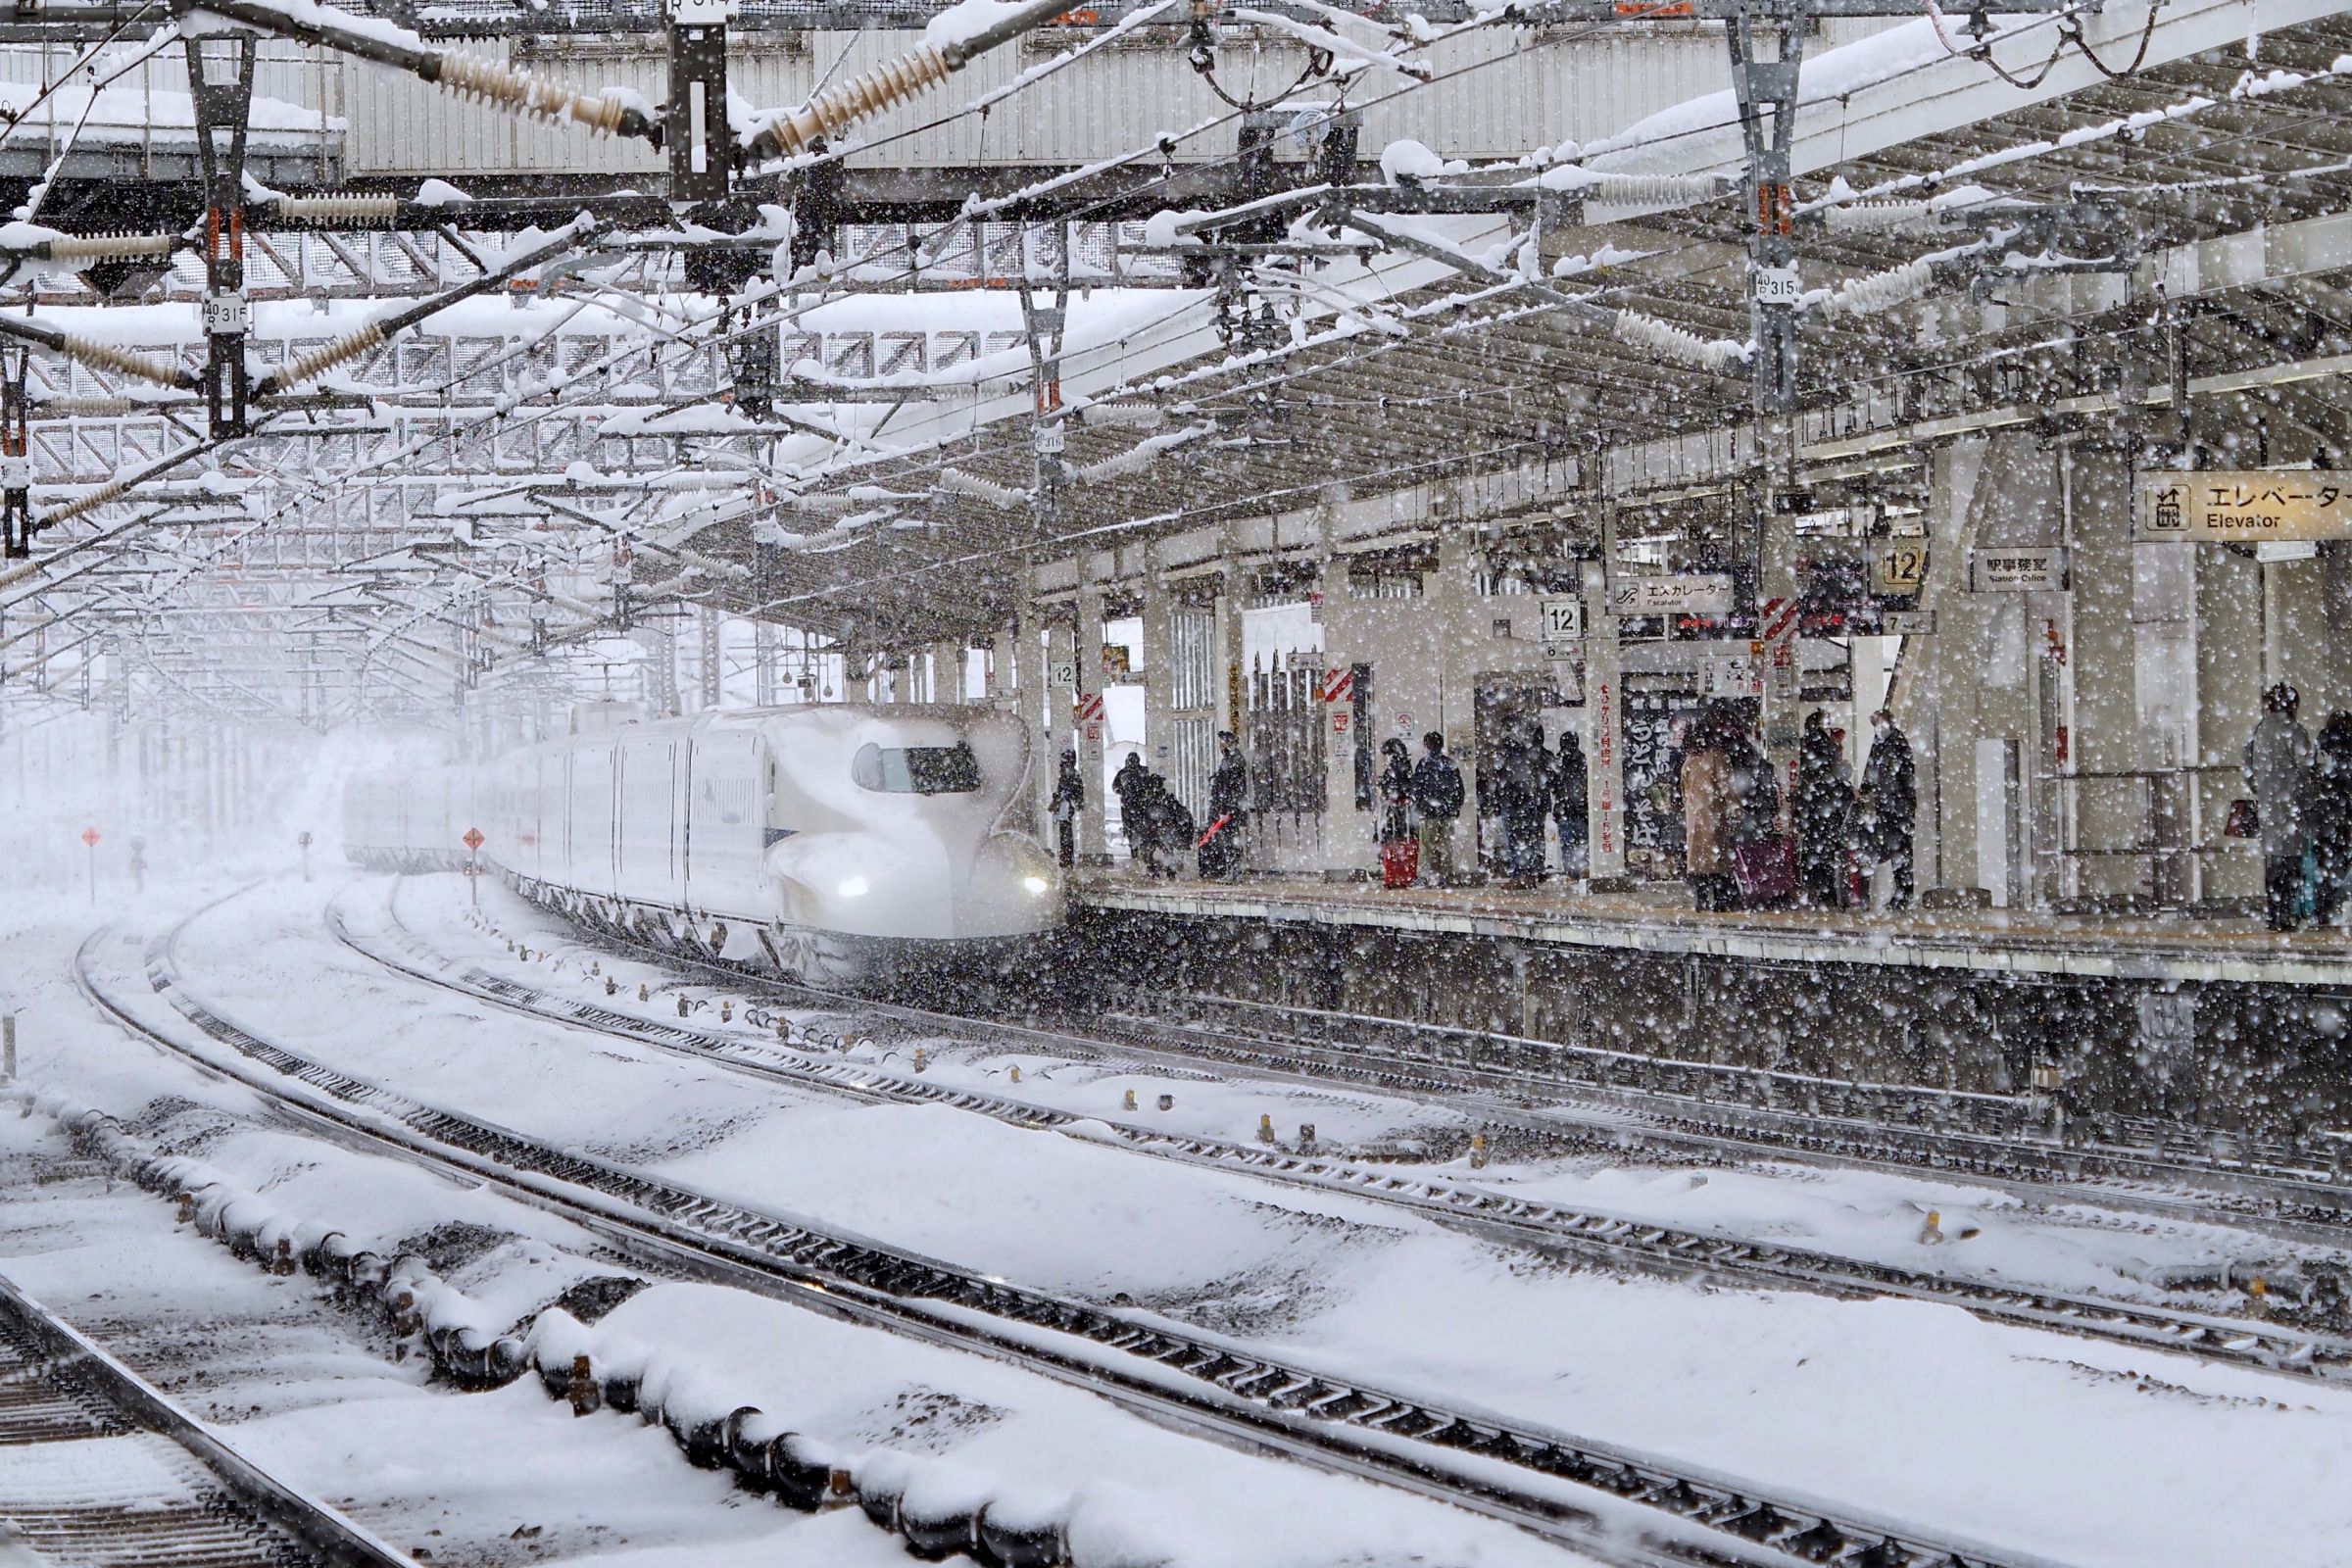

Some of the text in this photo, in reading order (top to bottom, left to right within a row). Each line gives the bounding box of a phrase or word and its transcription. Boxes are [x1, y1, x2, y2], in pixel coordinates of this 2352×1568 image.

[1771, 280, 1794, 295] 315
[206, 304, 219, 316] 40
[2207, 514, 2281, 528] Elevator
[1886, 552, 1917, 579] 12
[1550, 609, 1574, 630] 12
[1889, 616, 1898, 630] 7
[1055, 666, 1072, 682] 12
